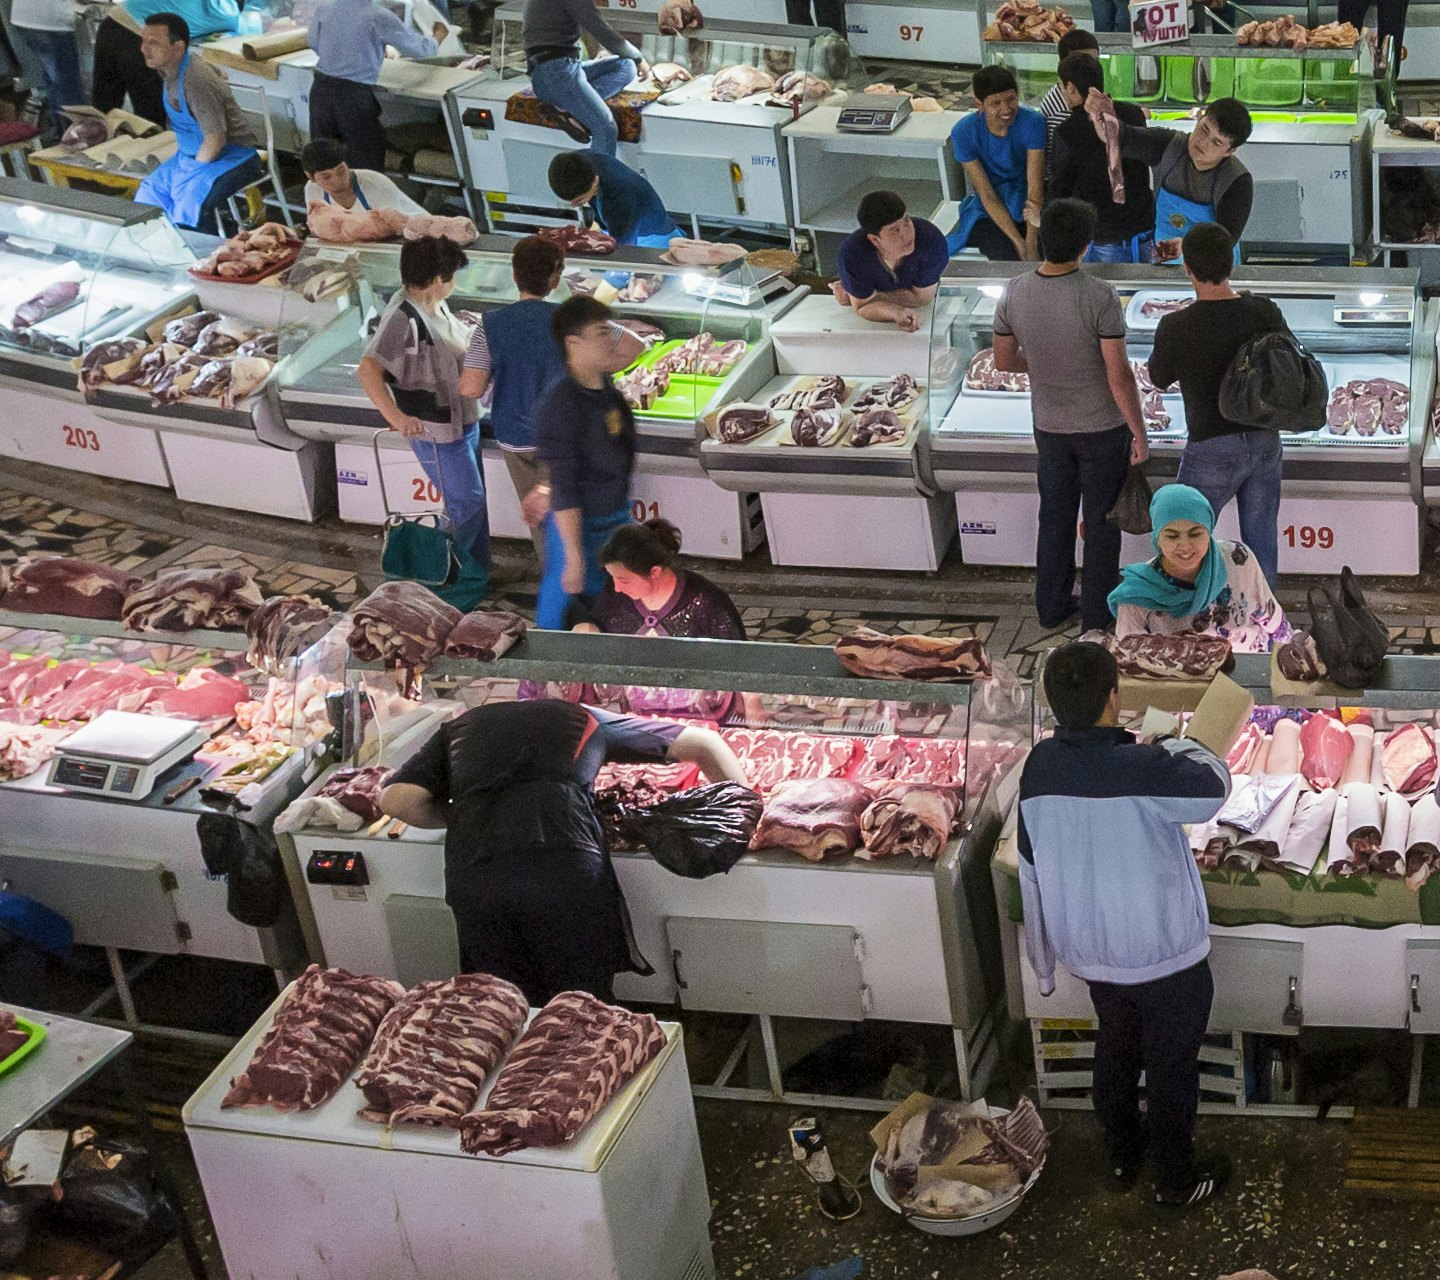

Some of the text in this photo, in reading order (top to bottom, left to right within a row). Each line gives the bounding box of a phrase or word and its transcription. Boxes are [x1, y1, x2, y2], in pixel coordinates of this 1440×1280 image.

[1147, 2, 1180, 25] ОТ
[899, 24, 924, 42] 97
[62, 424, 101, 452] 203
[412, 478, 442, 504] 20
[631, 499, 661, 524] 01
[1282, 525, 1335, 549] 199
